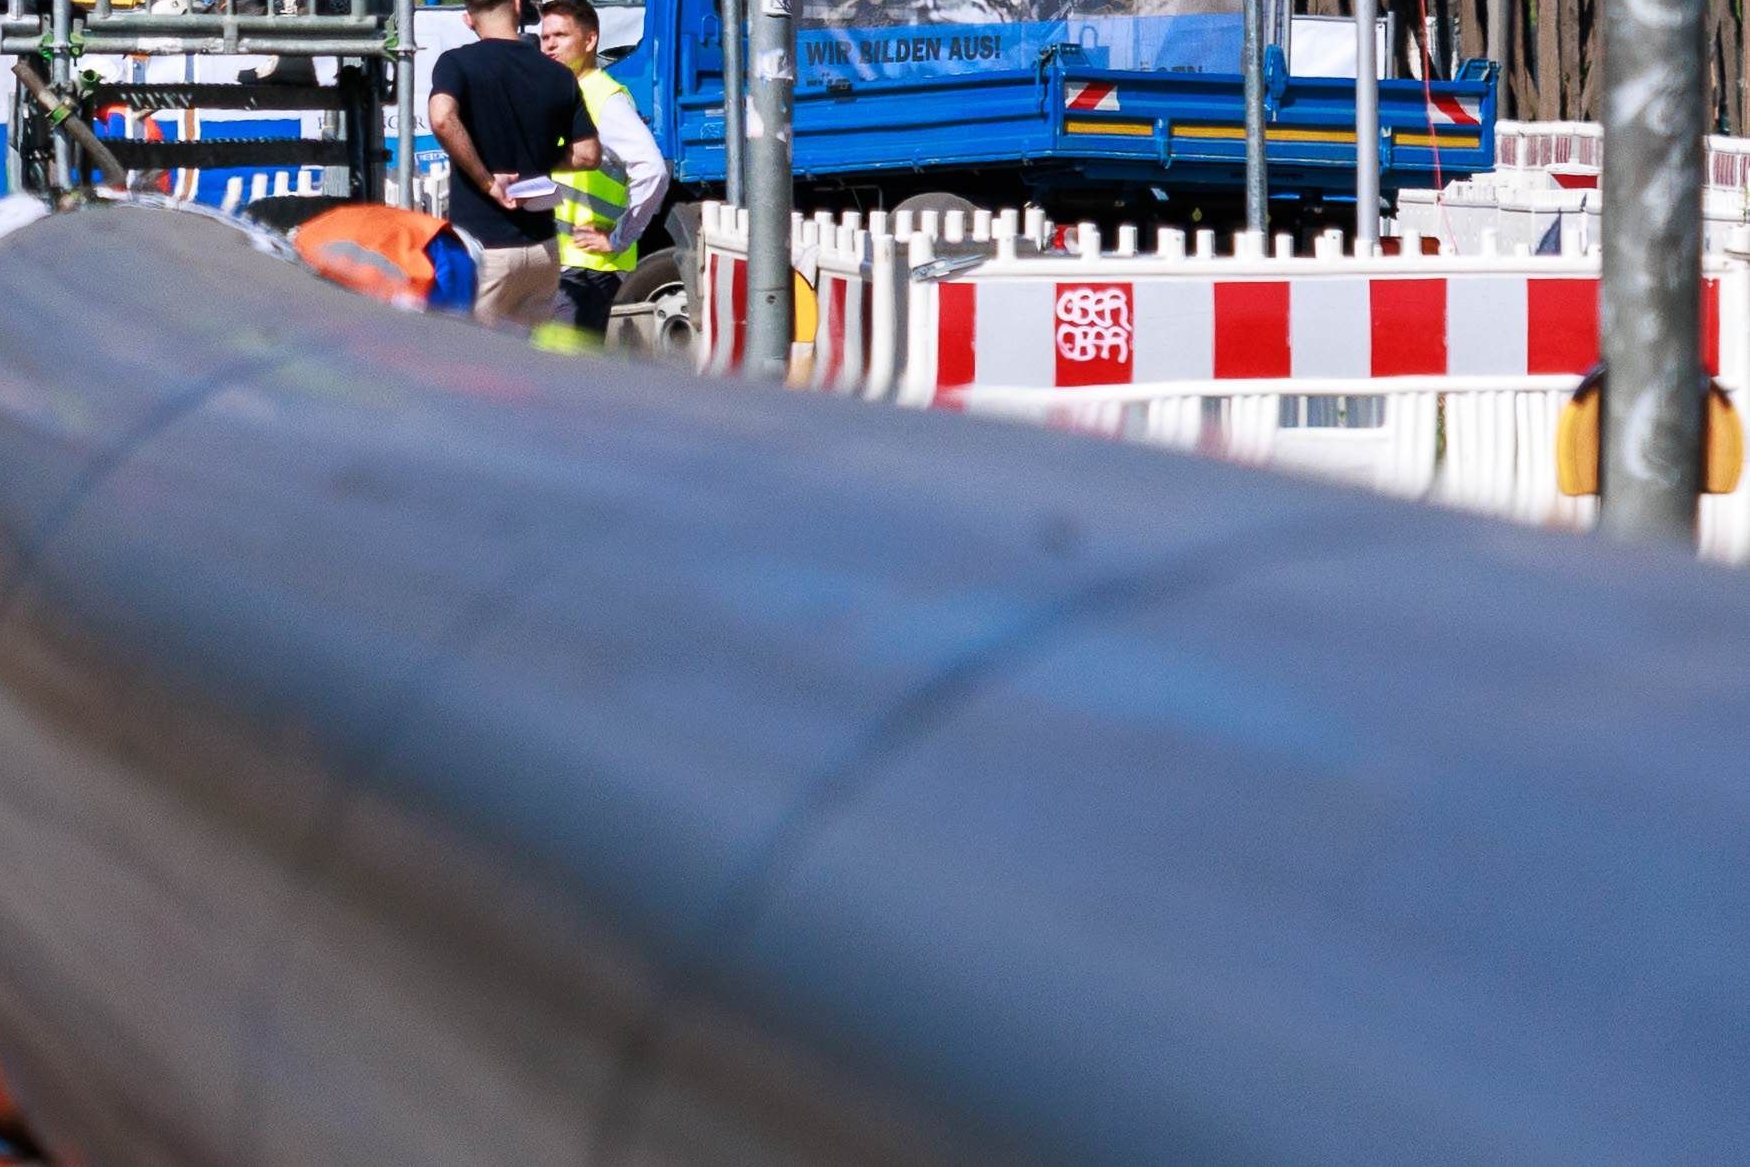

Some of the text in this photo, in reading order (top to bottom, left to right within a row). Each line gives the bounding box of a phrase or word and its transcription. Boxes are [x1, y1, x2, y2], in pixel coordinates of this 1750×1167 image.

[806, 34, 1002, 66] WIR BILDEN AUS!
